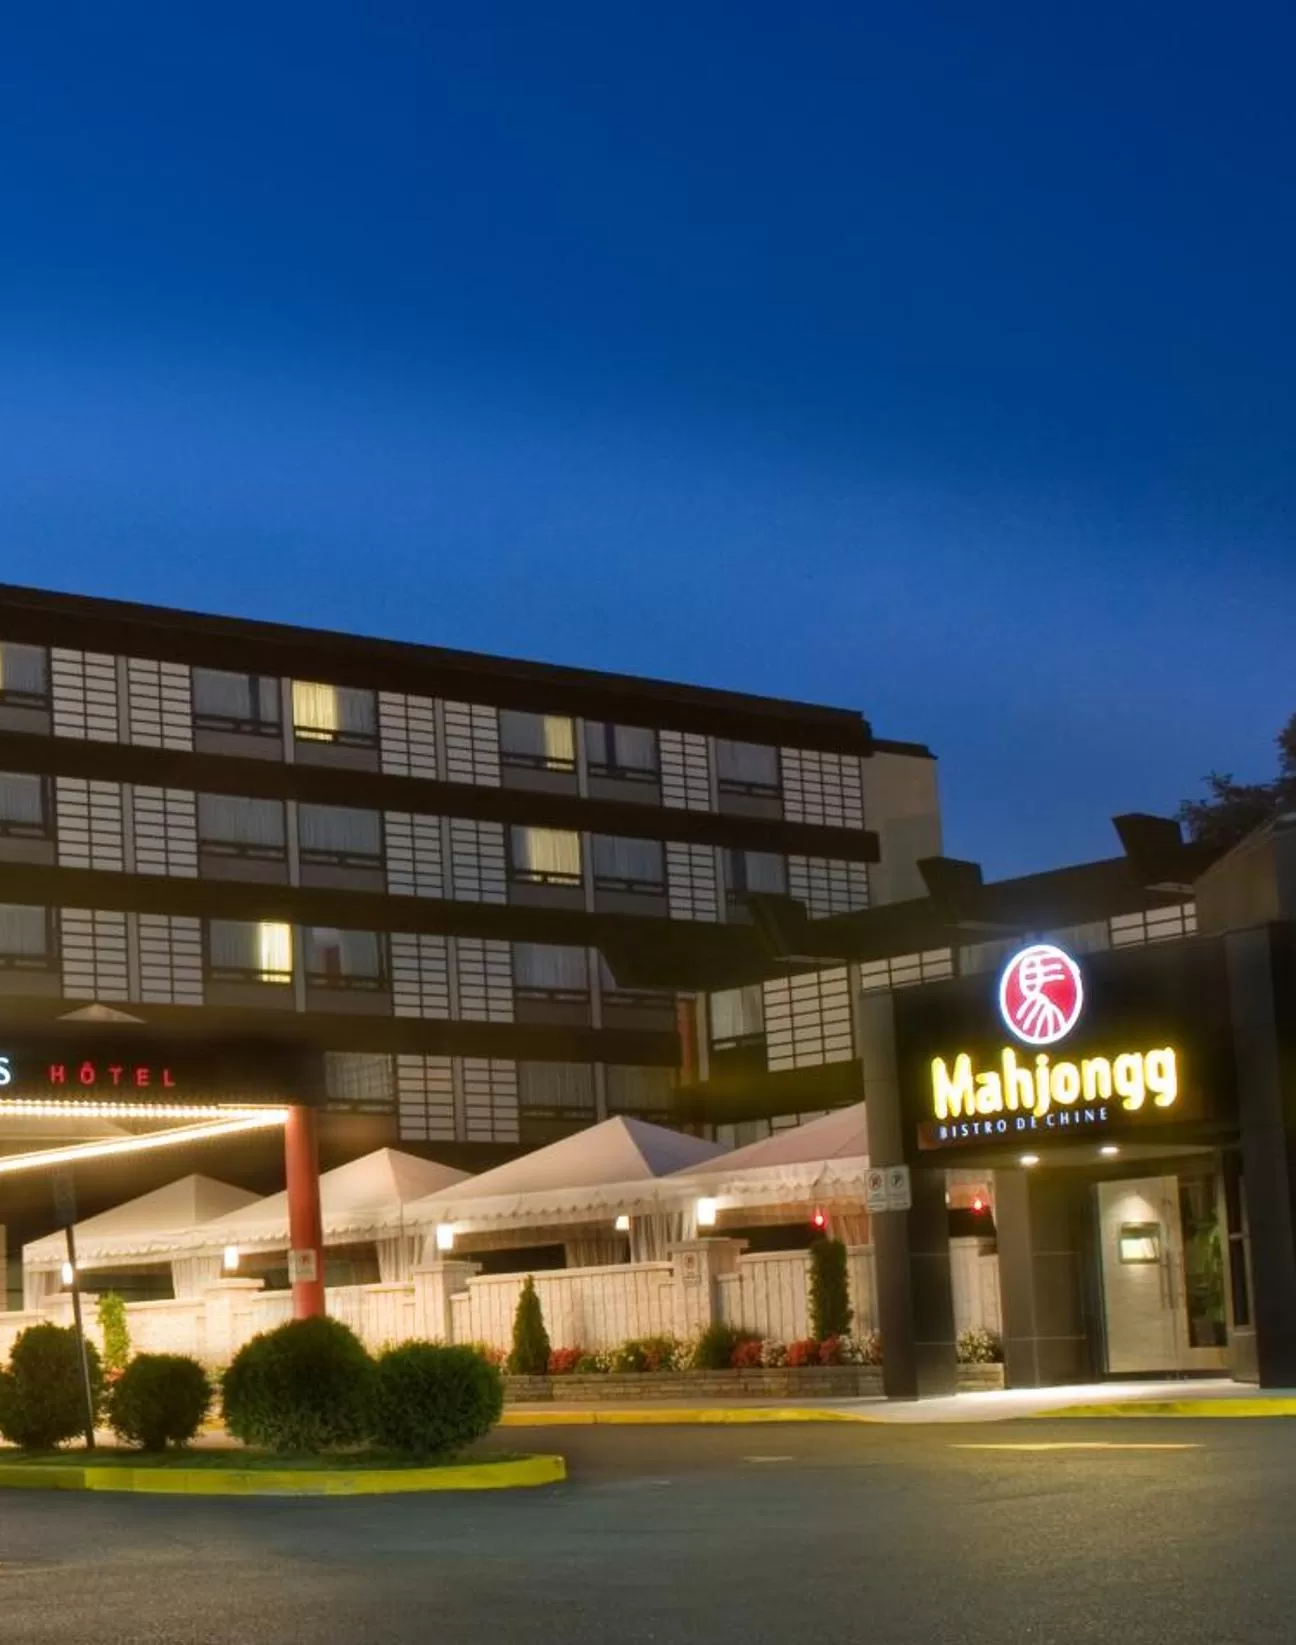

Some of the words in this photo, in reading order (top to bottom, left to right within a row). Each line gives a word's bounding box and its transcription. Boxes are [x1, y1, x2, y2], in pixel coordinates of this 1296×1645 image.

[50, 1060, 177, 1088] HÔTEL
[930, 1046, 1179, 1120] Mahjongg
[938, 1118, 1008, 1140] BISTRO
[1045, 1106, 1109, 1128] CHINE
